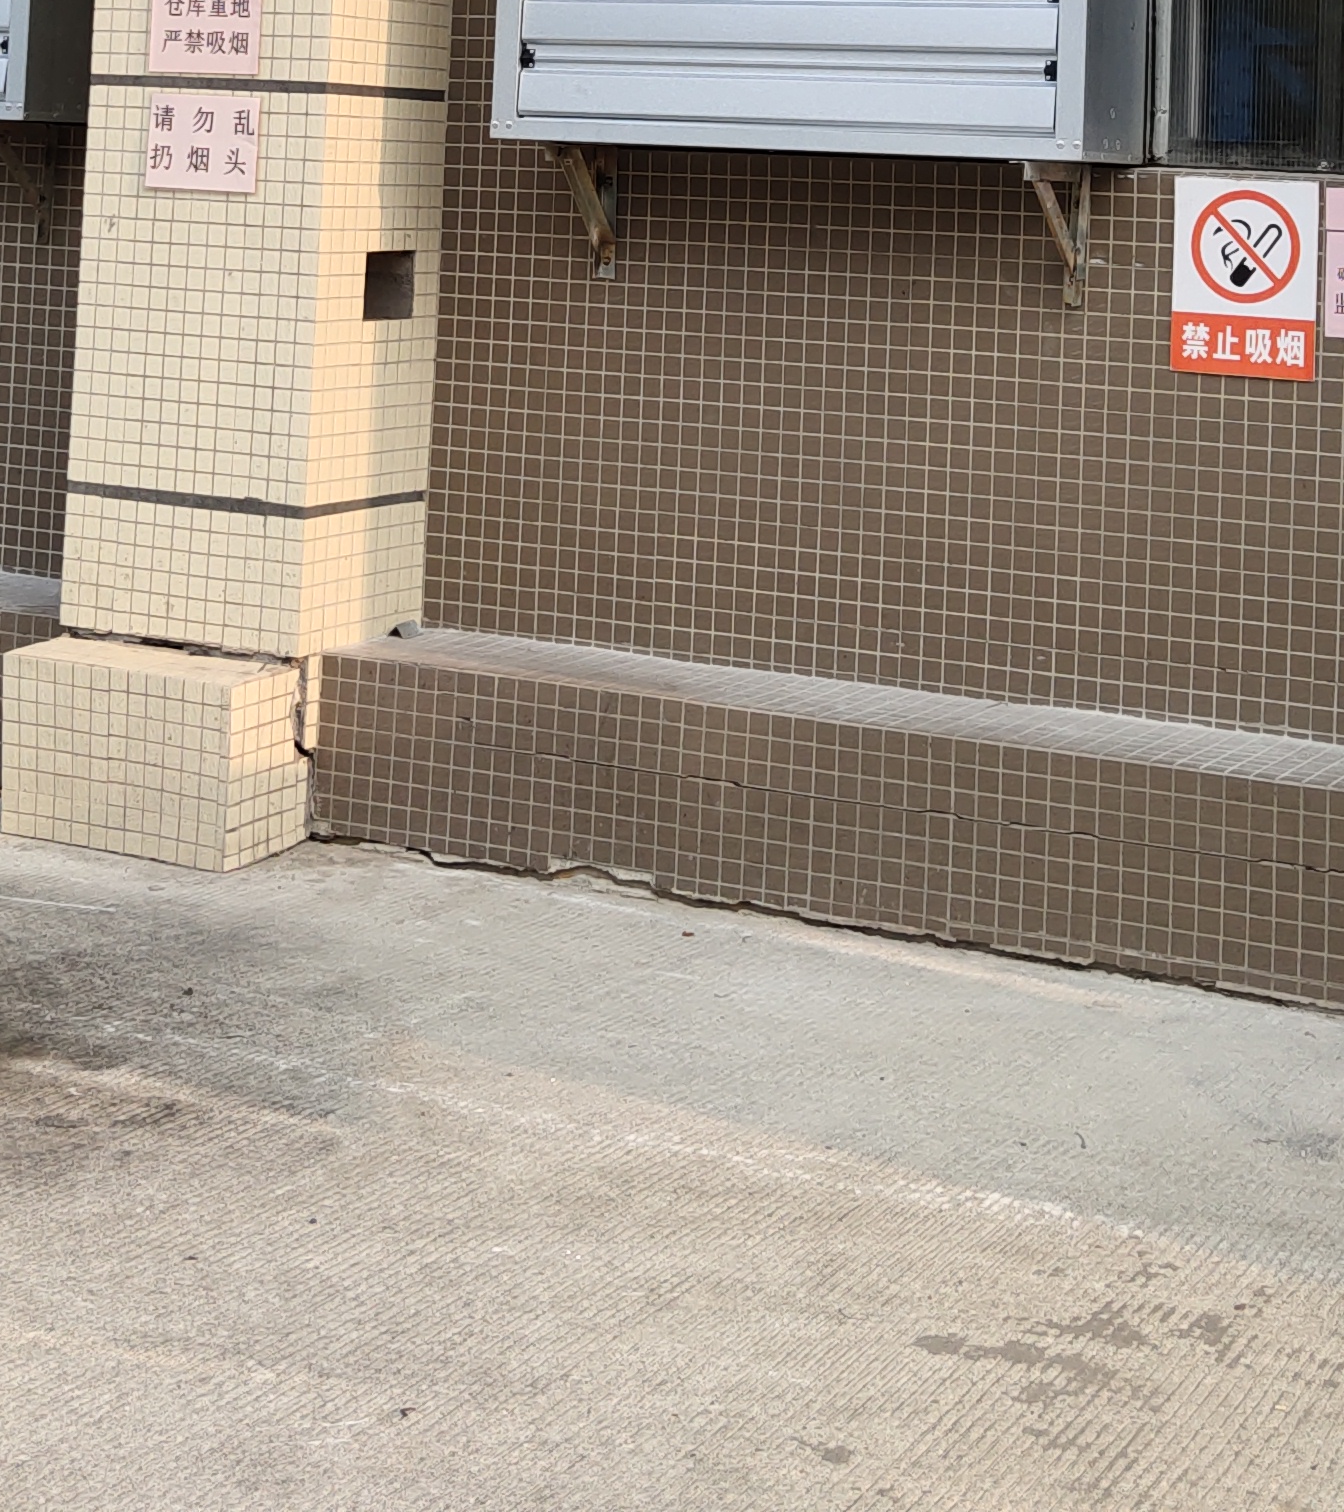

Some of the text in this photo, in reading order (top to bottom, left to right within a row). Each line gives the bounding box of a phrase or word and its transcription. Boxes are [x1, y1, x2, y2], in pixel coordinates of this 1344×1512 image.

[161, 28, 250, 56] 严禁吸烟
[153, 103, 255, 138] 请勿乱
[149, 143, 247, 176] 扔烟头
[1181, 321, 1305, 369] 禁止吸烟
